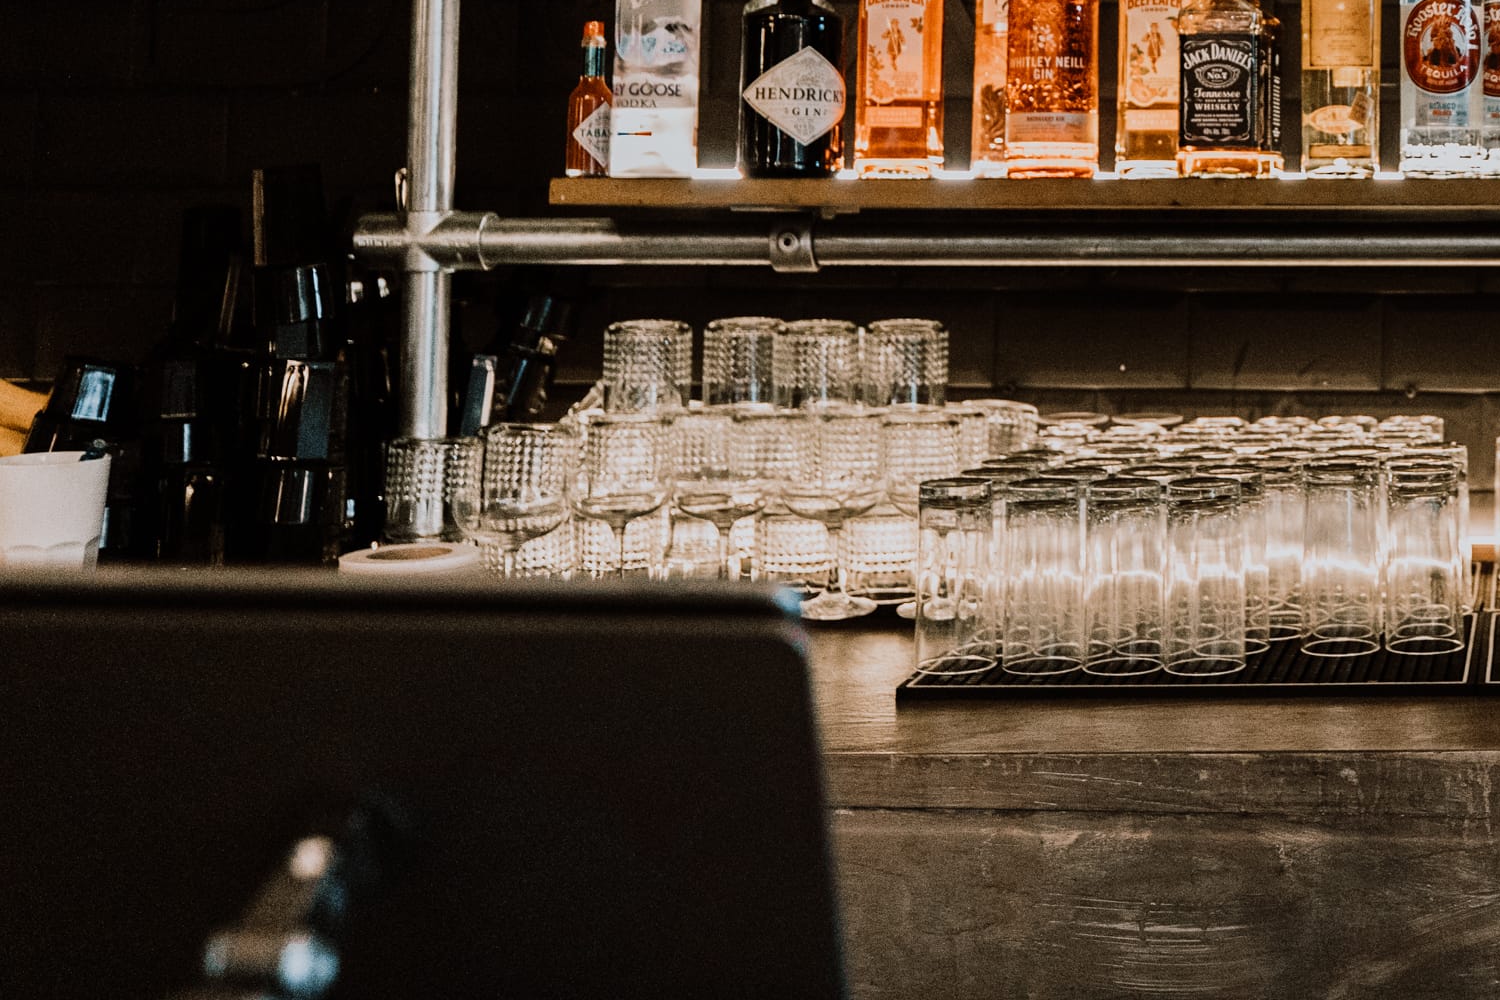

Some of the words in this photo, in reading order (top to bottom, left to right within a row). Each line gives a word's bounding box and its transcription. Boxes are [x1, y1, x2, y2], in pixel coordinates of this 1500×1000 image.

[1407, 1, 1456, 37] Rooster
[1056, 55, 1085, 68] NEILL
[1183, 48, 1210, 70] JACK
[1033, 68, 1054, 80] GIN
[1421, 64, 1468, 79] TEQUILA
[629, 80, 682, 97] GOOSE
[1194, 87, 1240, 98] Tennessee
[792, 107, 820, 116] GIN
[1194, 103, 1240, 111] WHISKEY
